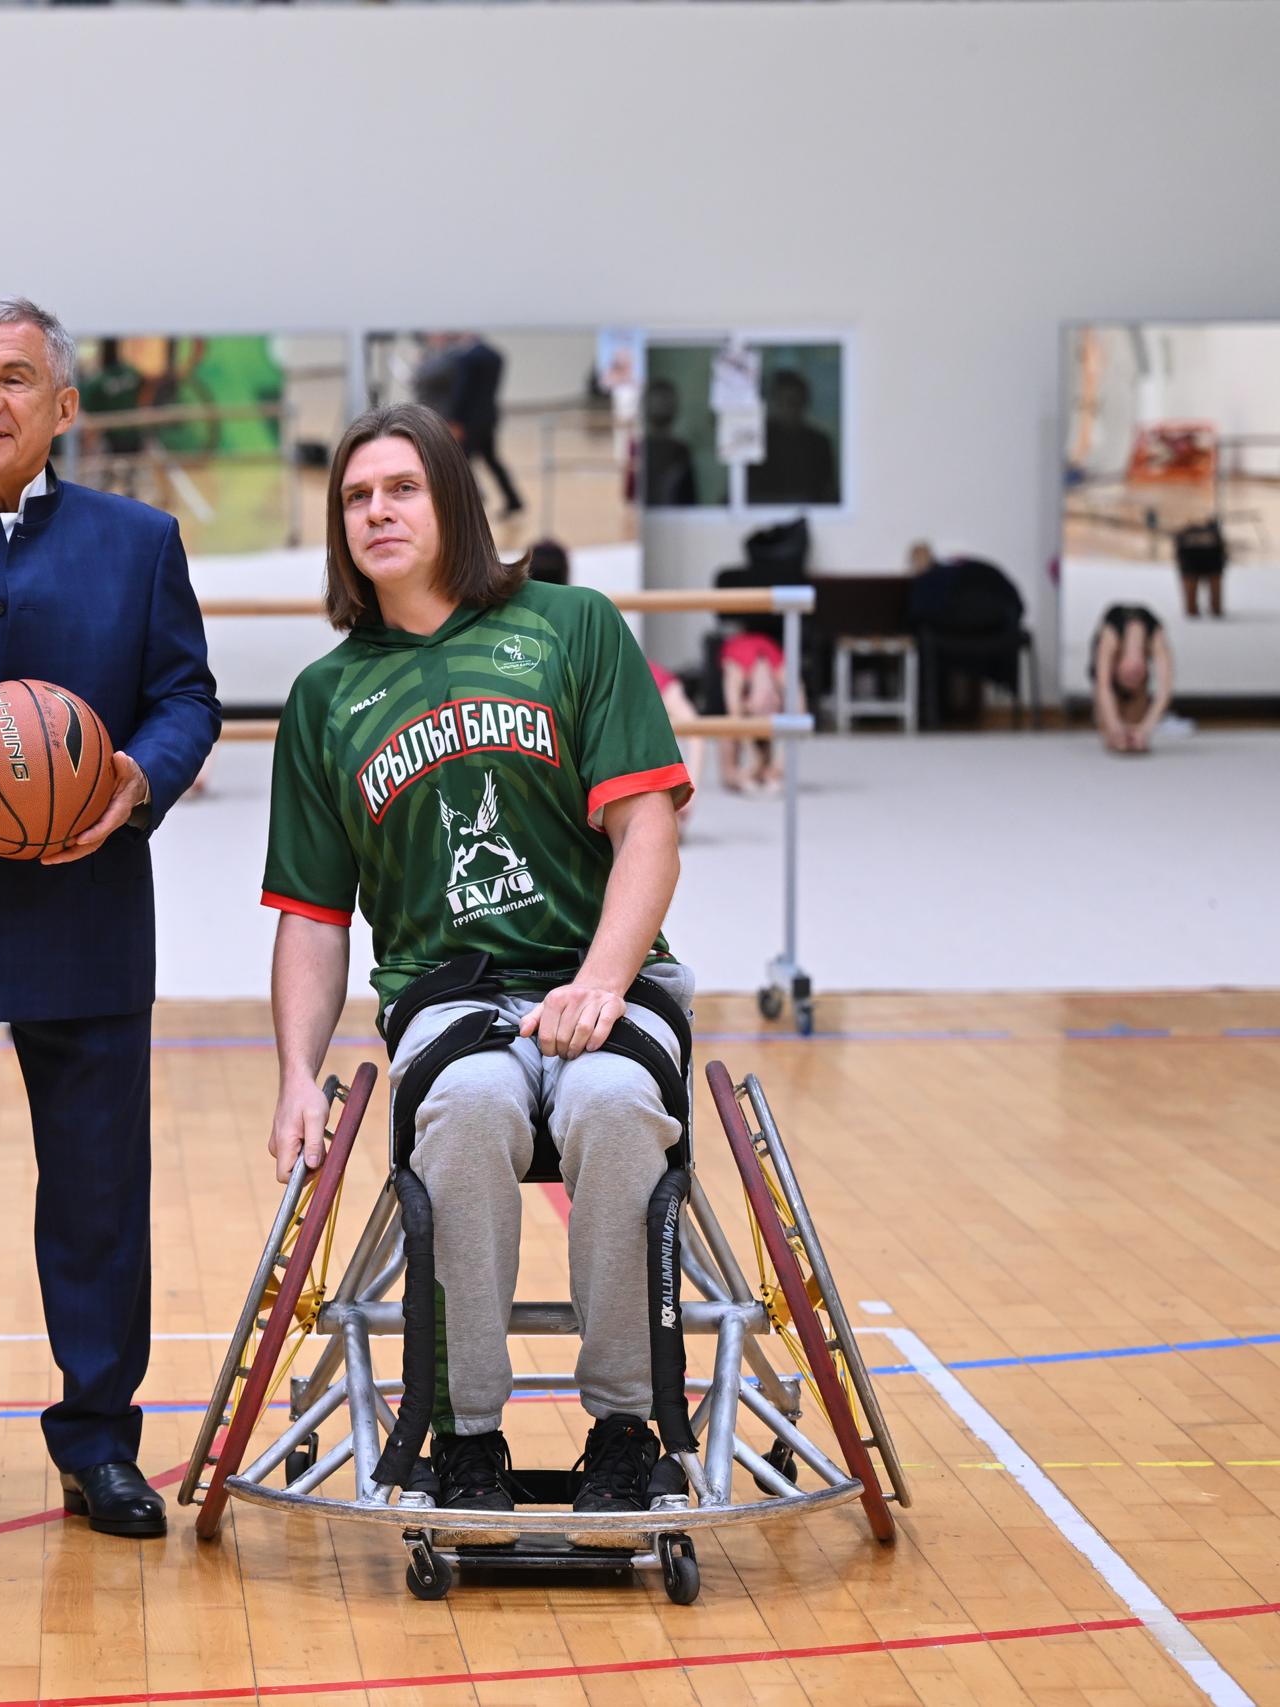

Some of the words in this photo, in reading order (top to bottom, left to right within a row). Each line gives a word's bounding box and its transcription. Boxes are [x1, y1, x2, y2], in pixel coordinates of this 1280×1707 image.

[350, 688, 387, 715] MAXX
[361, 708, 462, 815] КРЫЛЬЯ
[462, 703, 553, 757] БАРСА
[446, 870, 534, 915] ТАИФ
[452, 907, 492, 928] ГРУППА
[489, 892, 545, 915] КОМПАНИИ
[661, 1225, 675, 1305] ALUMINIUM
